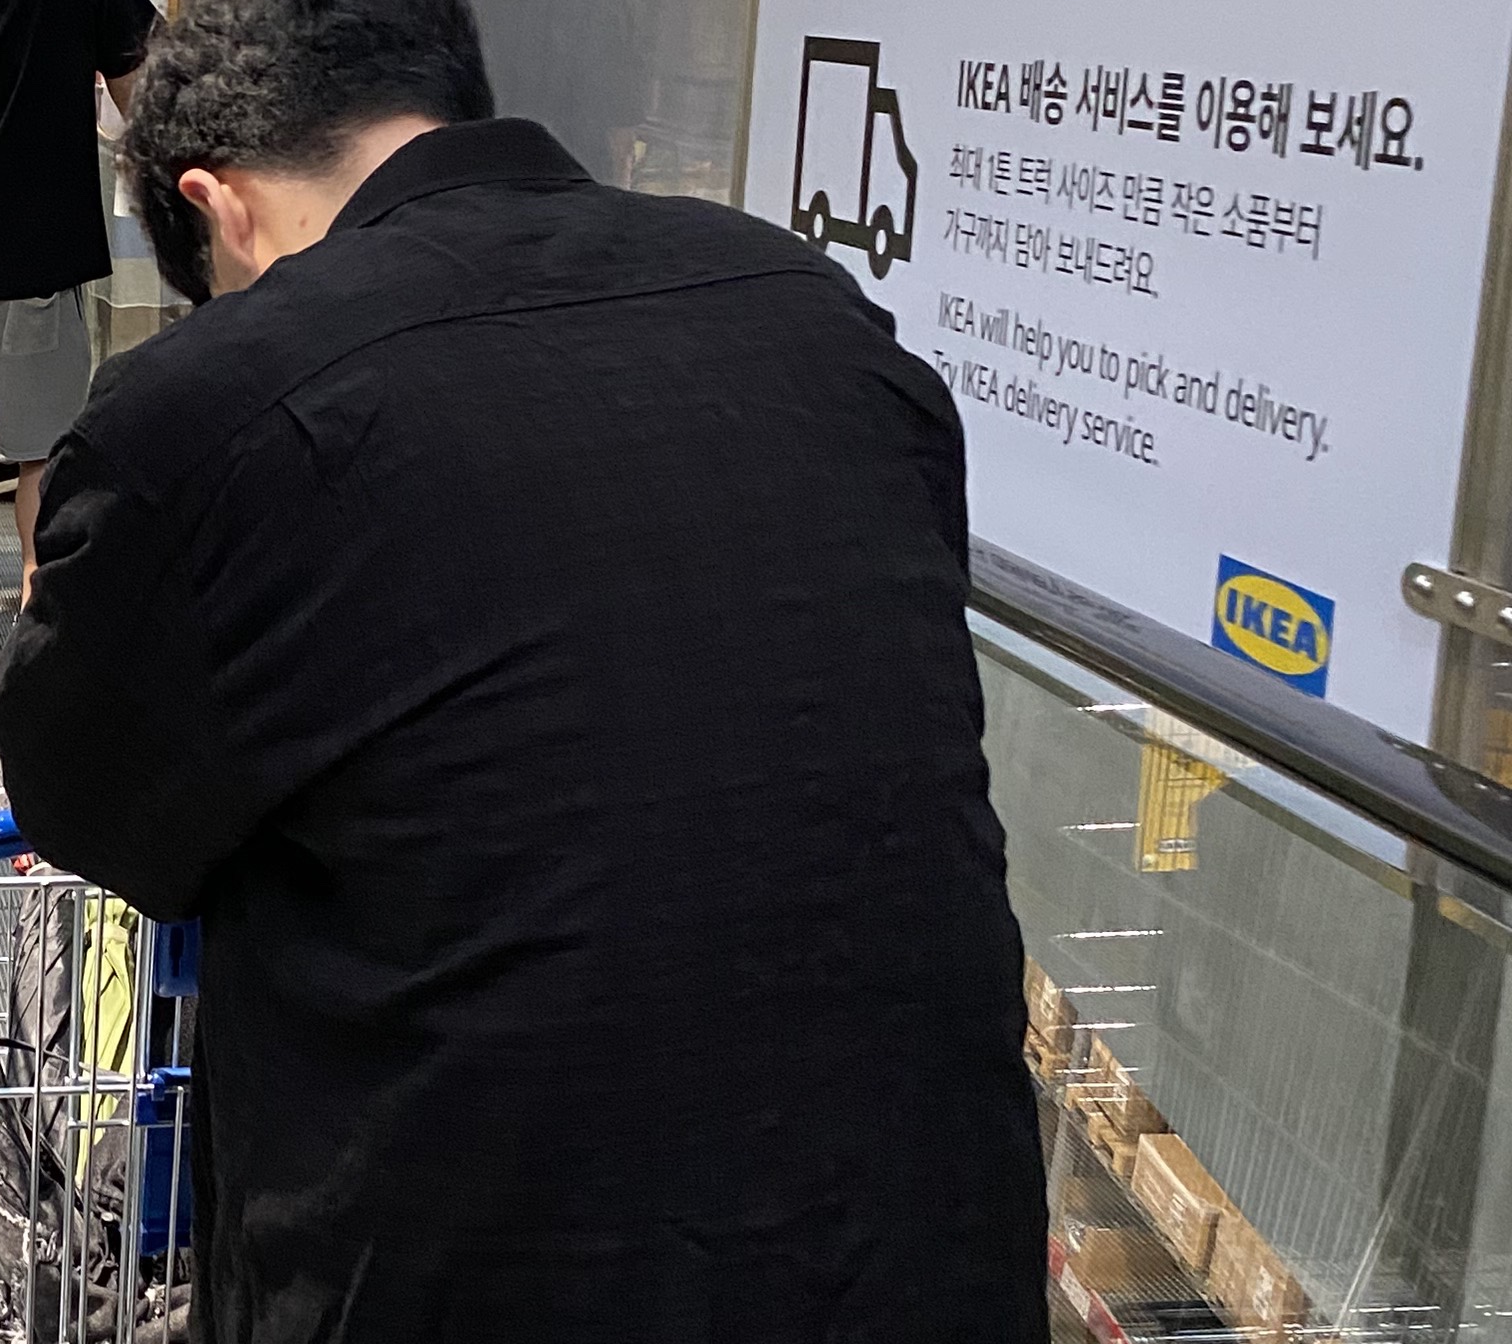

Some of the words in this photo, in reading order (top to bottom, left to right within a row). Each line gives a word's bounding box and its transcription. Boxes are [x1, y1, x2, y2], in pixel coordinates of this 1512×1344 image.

[956, 59, 1012, 114] IKEA
[1020, 59, 1068, 125] 배송
[1075, 63, 1186, 143] 서비스를
[1195, 75, 1293, 158] 이용해
[1299, 89, 1425, 171] 보세요.
[944, 207, 1010, 264] 가구까지
[1015, 222, 1052, 273] 담아
[1055, 233, 1160, 300] 보내드려요.
[949, 143, 983, 190] 최대
[989, 150, 1012, 196] 1톤
[1016, 156, 1052, 205] 트럭
[1056, 161, 1116, 215] 사이즈
[1121, 172, 1165, 227] 만큼
[1171, 182, 1215, 237] 작은
[1220, 192, 1324, 261] 소품부터
[938, 290, 975, 334] IKEA
[979, 308, 1010, 348] will
[1012, 311, 1053, 372] help
[1056, 334, 1094, 378] you
[1098, 342, 1120, 384] to
[1124, 350, 1170, 400] pick
[1173, 369, 1220, 415] and
[1224, 377, 1330, 462] delivery.
[960, 360, 1001, 408] IKEA
[1004, 374, 1079, 445] delivery
[1080, 408, 1161, 468] service.
[1225, 586, 1318, 664] IKEA
